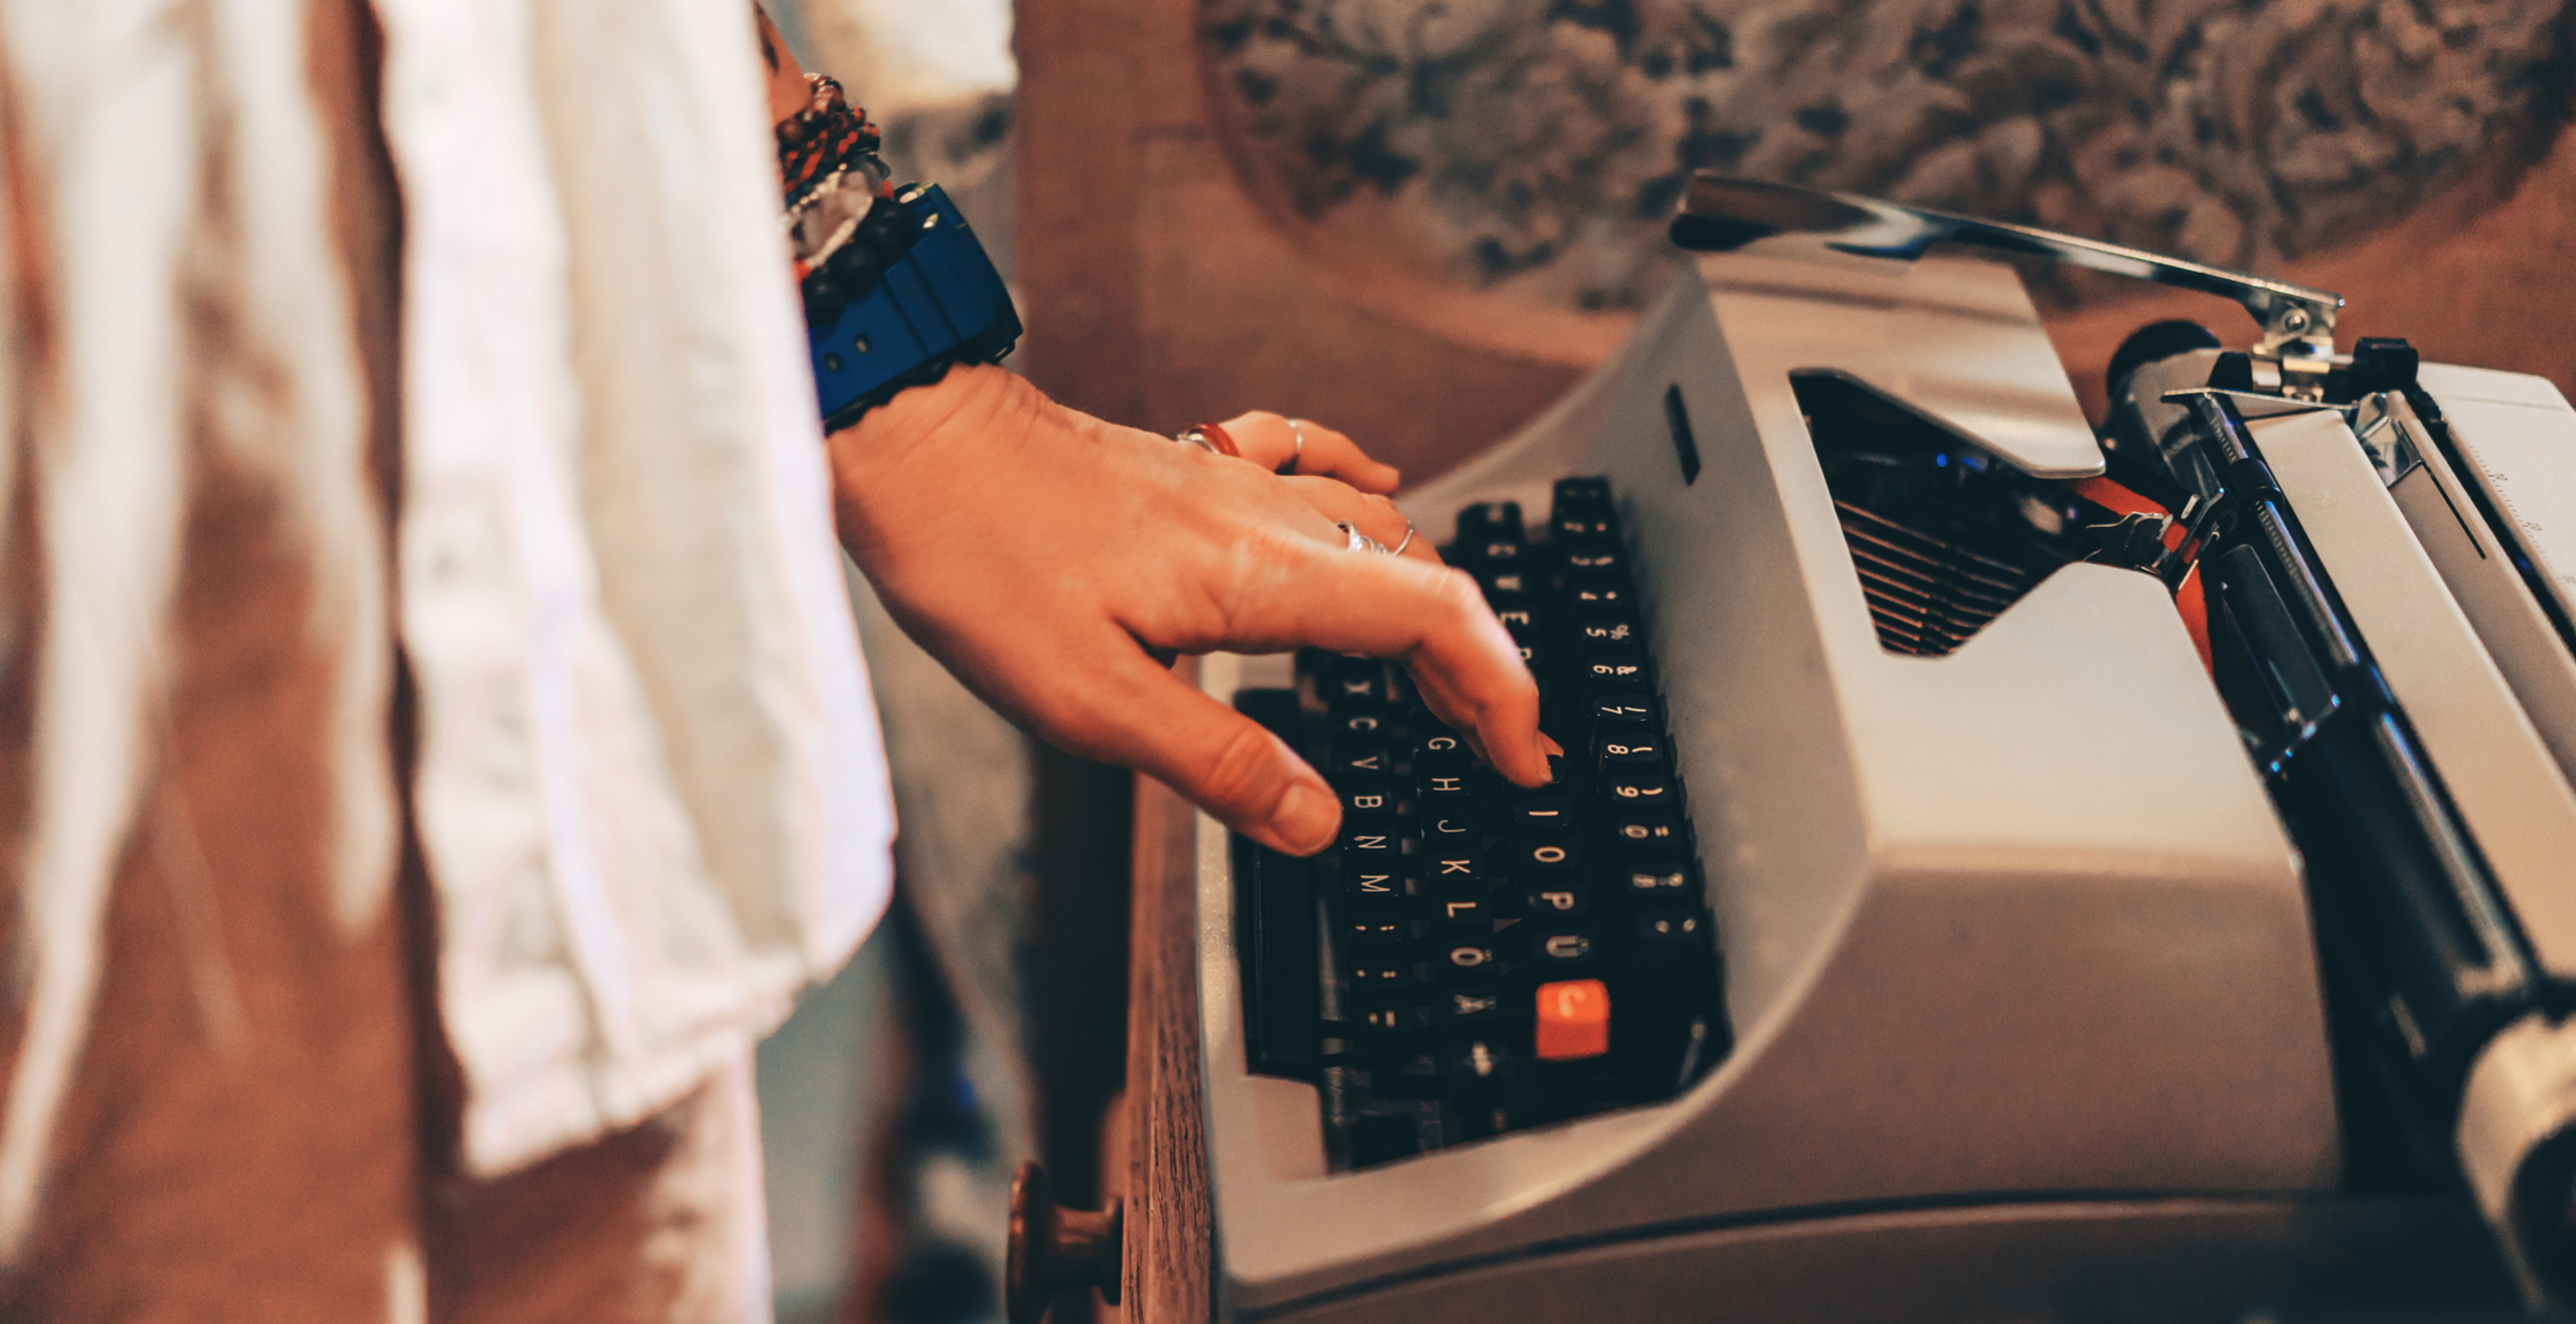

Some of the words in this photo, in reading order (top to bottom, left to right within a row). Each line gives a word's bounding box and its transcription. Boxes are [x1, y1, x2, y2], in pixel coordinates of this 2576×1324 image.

[1586, 626, 1607, 638] 5
[1592, 664, 1614, 675] 6
[1614, 665, 1638, 676] &
[1601, 704, 1623, 716] 7
[1348, 717, 1378, 732] C
[1428, 736, 1457, 751] G
[1606, 743, 1630, 754] 8
[1351, 755, 1379, 771] V
[1431, 777, 1462, 793] H
[1615, 785, 1640, 799] 9
[1353, 794, 1384, 810] B
[1437, 819, 1468, 835] J
[1355, 834, 1388, 850] N
[1533, 844, 1567, 864] O
[1440, 859, 1472, 875] K
[1360, 873, 1392, 893] M
[1541, 891, 1575, 912] P
[1446, 901, 1478, 919] L
